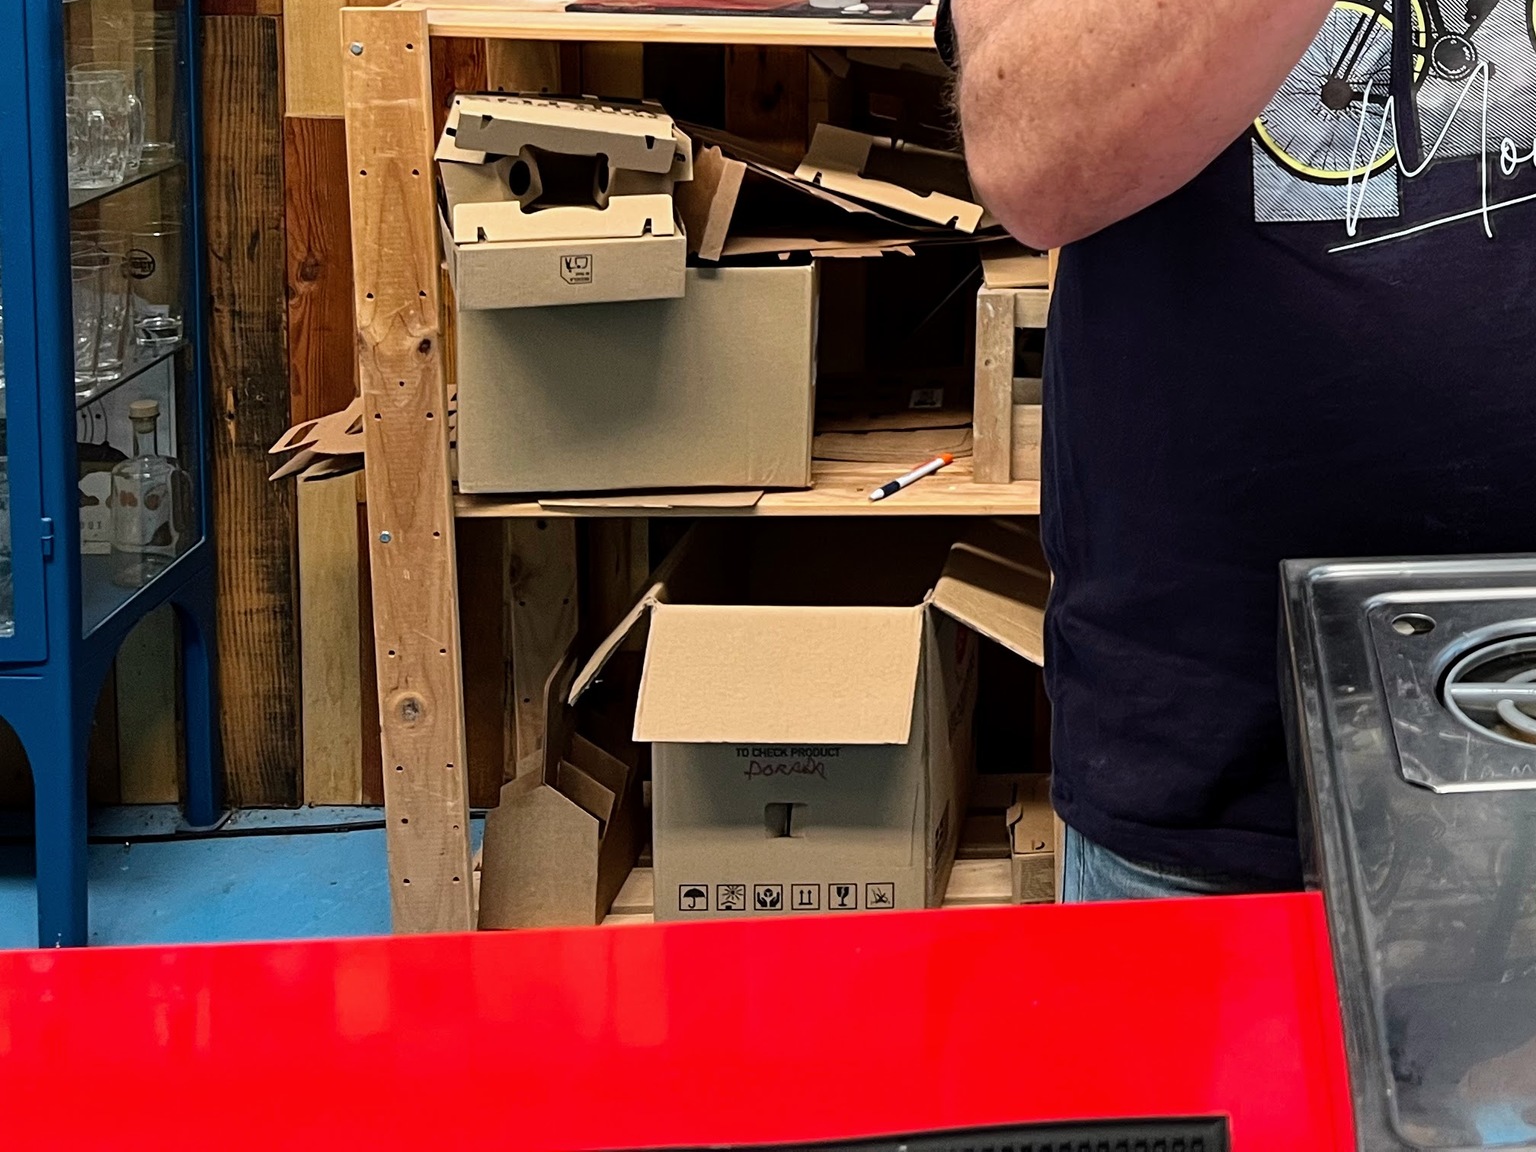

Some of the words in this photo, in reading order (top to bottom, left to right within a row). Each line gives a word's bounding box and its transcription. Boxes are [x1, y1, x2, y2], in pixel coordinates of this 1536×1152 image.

[736, 748, 749, 757] TO
[752, 748, 788, 758] CHECK
[791, 747, 841, 757] PRODUCT
